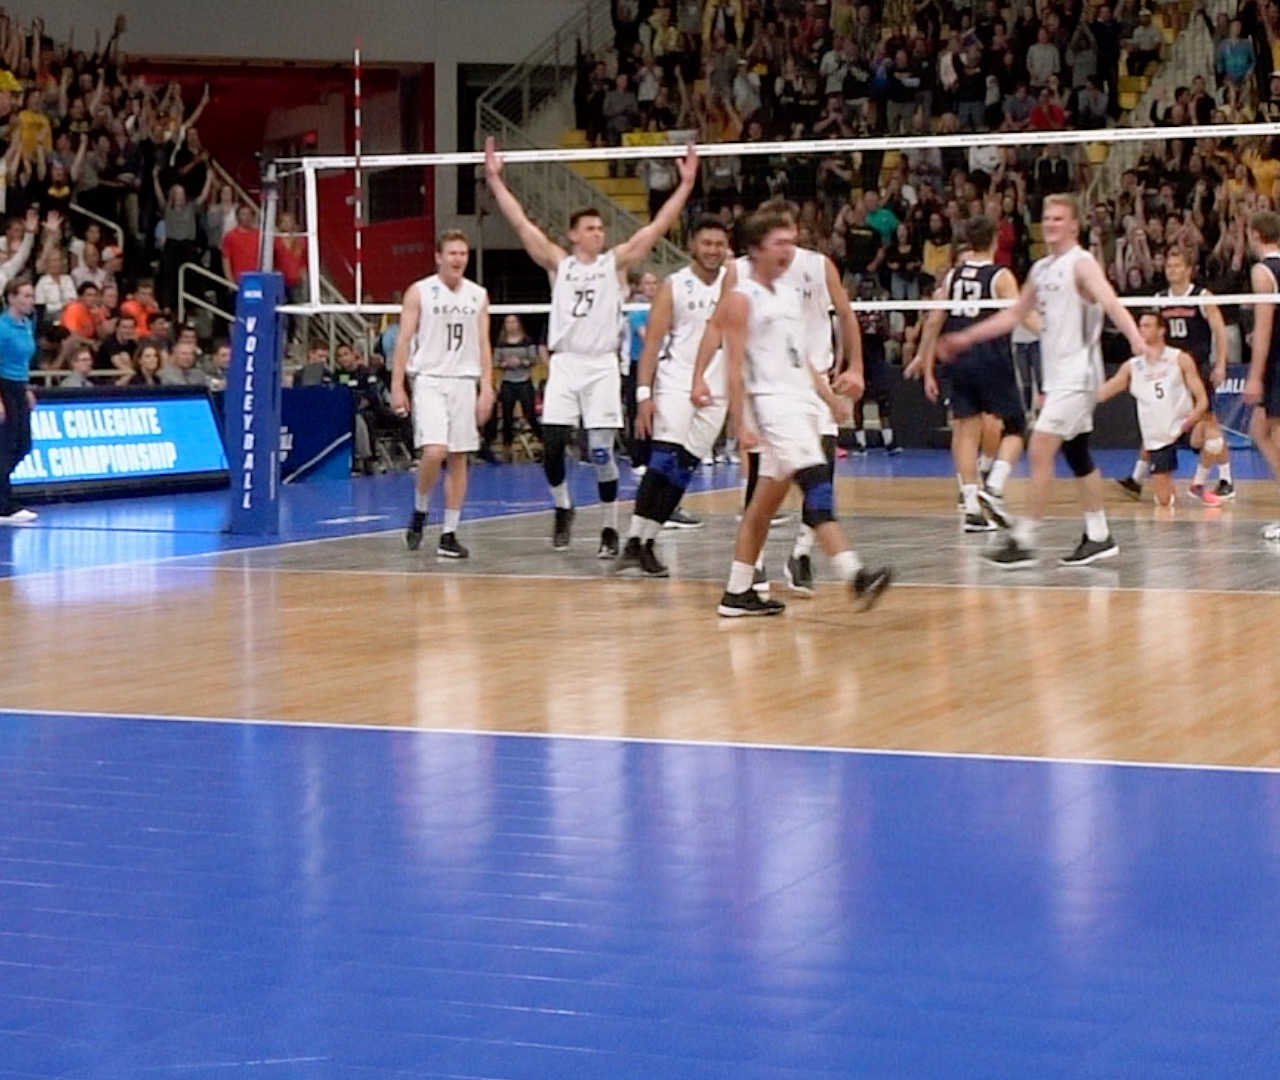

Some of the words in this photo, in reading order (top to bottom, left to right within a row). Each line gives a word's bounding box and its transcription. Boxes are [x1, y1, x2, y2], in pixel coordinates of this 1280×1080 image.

[571, 289, 595, 318] 25
[446, 323, 464, 352] 19
[1169, 318, 1188, 338] 10
[1155, 382, 1165, 399] 5
[63, 407, 161, 439] COLLEGIATE
[241, 316, 258, 509] VOLLEYBALL
[48, 442, 176, 477] CHAMPIONSHIP
